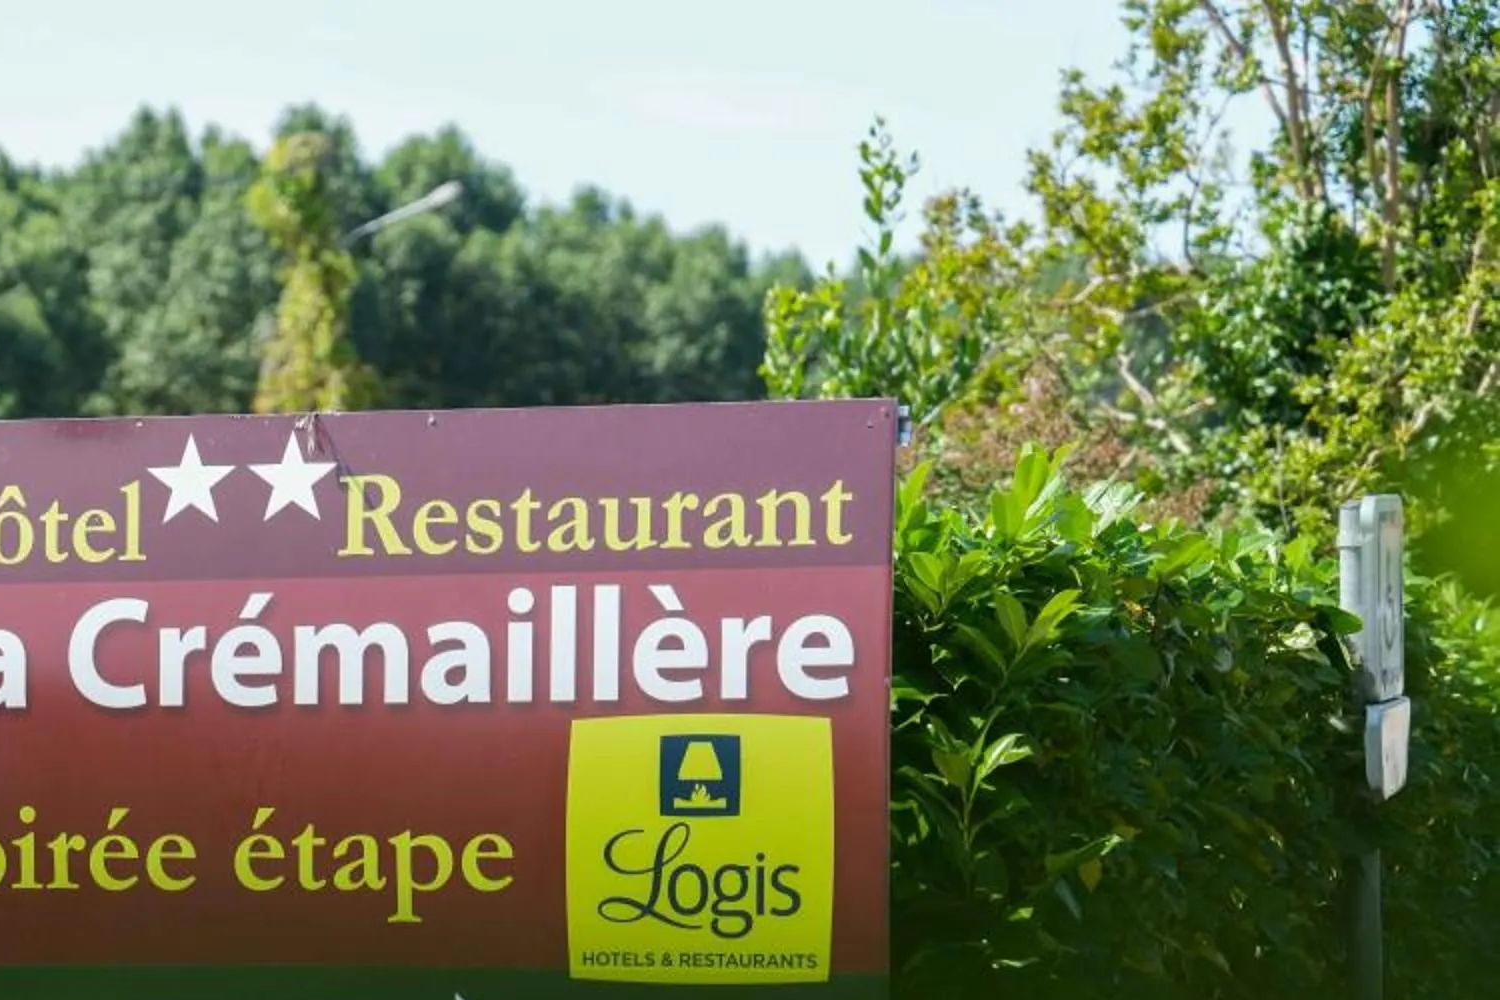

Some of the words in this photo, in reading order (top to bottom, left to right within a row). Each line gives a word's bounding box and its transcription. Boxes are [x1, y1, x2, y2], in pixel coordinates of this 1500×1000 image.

[337, 473, 854, 557] Restaurant
[68, 584, 855, 709] Crémaillère
[234, 807, 514, 923] étape
[597, 821, 802, 939] Logis
[581, 951, 656, 967] HOTELS
[660, 952, 674, 967] &
[678, 953, 819, 970] RESTAURANTS
